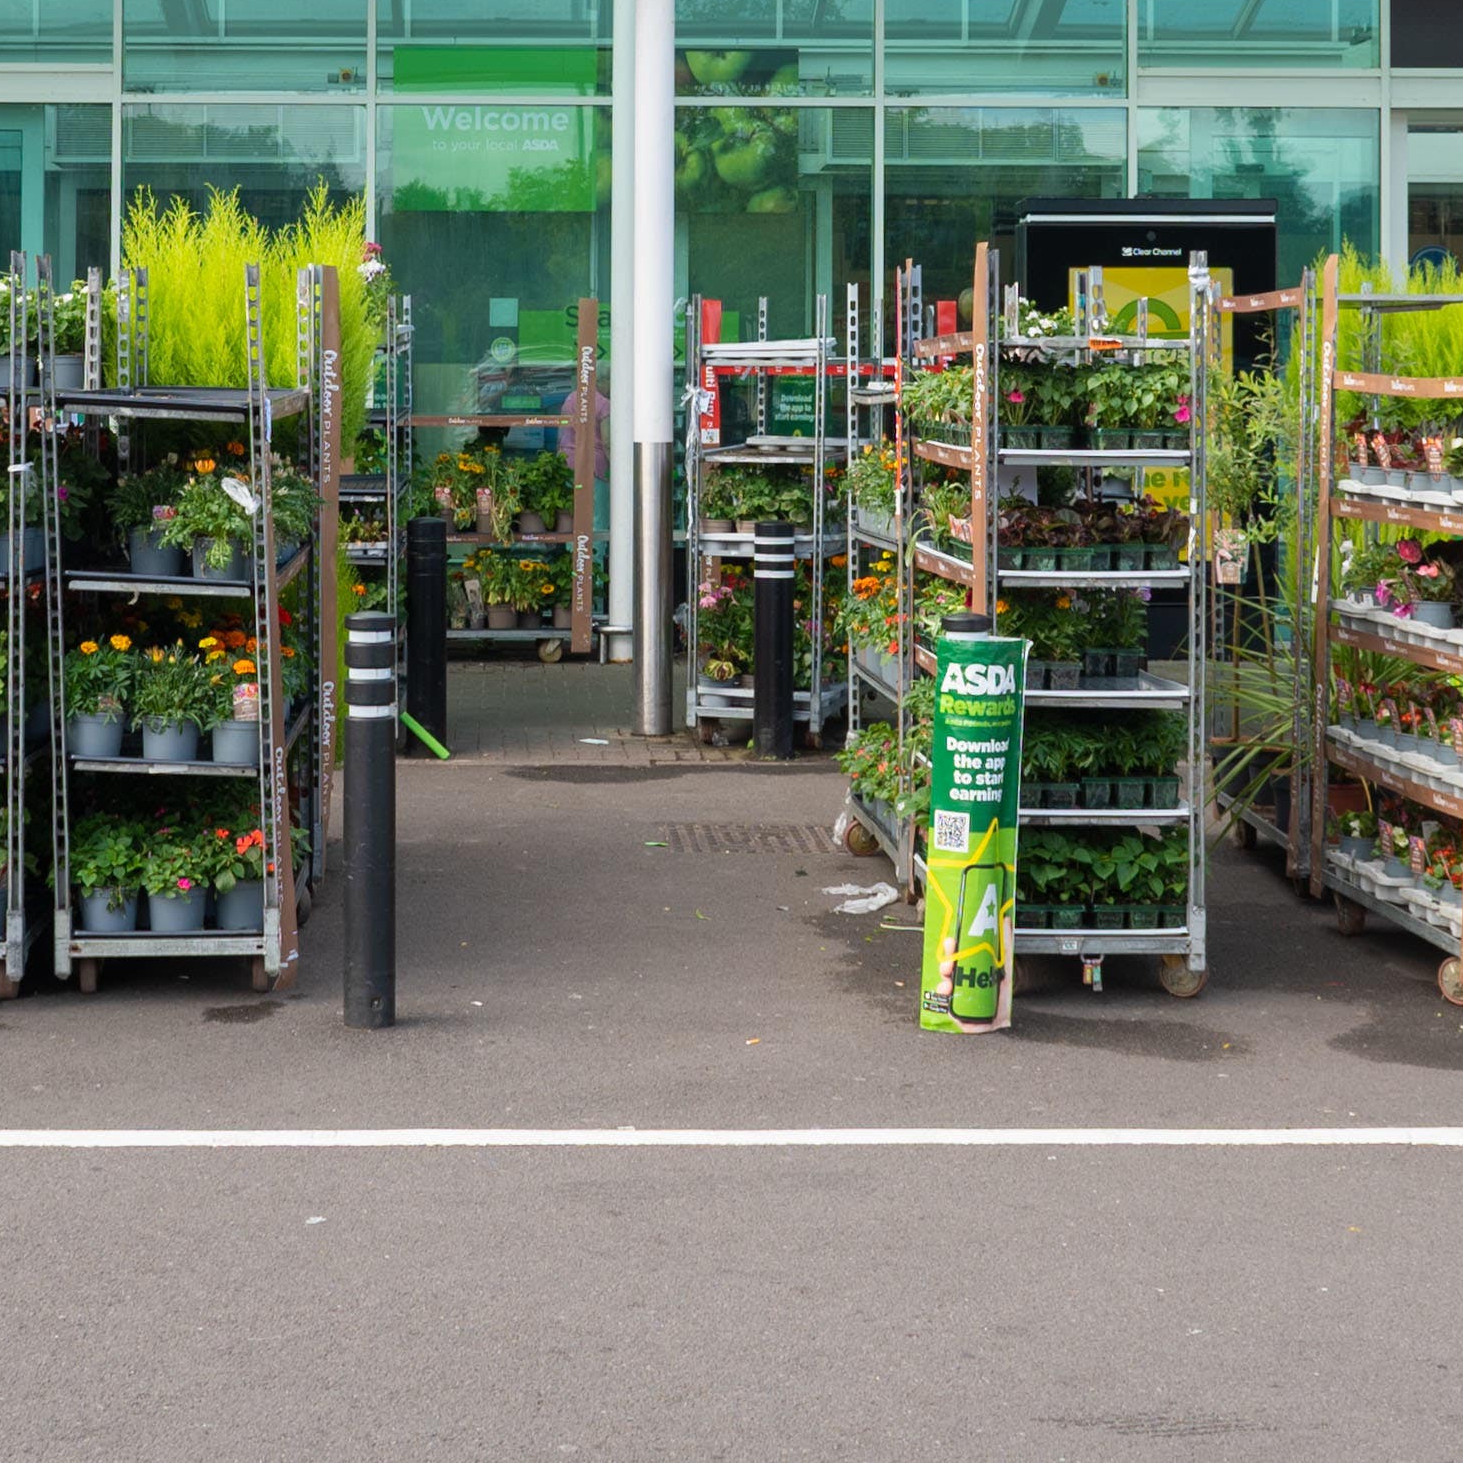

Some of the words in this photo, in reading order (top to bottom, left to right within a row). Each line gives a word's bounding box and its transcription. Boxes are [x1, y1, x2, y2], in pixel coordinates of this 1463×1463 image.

[421, 105, 569, 131] Welcome
[433, 140, 446, 151] to
[451, 141, 481, 153] your
[487, 139, 518, 151] local
[522, 139, 559, 151] ASDA
[1133, 247, 1152, 256] Clear
[1153, 247, 1182, 256] Channel
[323, 349, 339, 417] Outdoor
[581, 346, 595, 384] Outdoor
[705, 366, 716, 387] ulti
[975, 343, 985, 422] Outdoor
[323, 420, 332, 483] PLANTS
[974, 427, 982, 499] PLANTS
[576, 535, 590, 573] Outdoor
[576, 576, 585, 612] PLANTS
[940, 662, 1016, 696] ASDA
[322, 681, 335, 751] Outdoor
[939, 694, 1016, 716] Rewards
[953, 754, 982, 769] the
[953, 770, 972, 785] to
[275, 746, 287, 825] Outdoor
